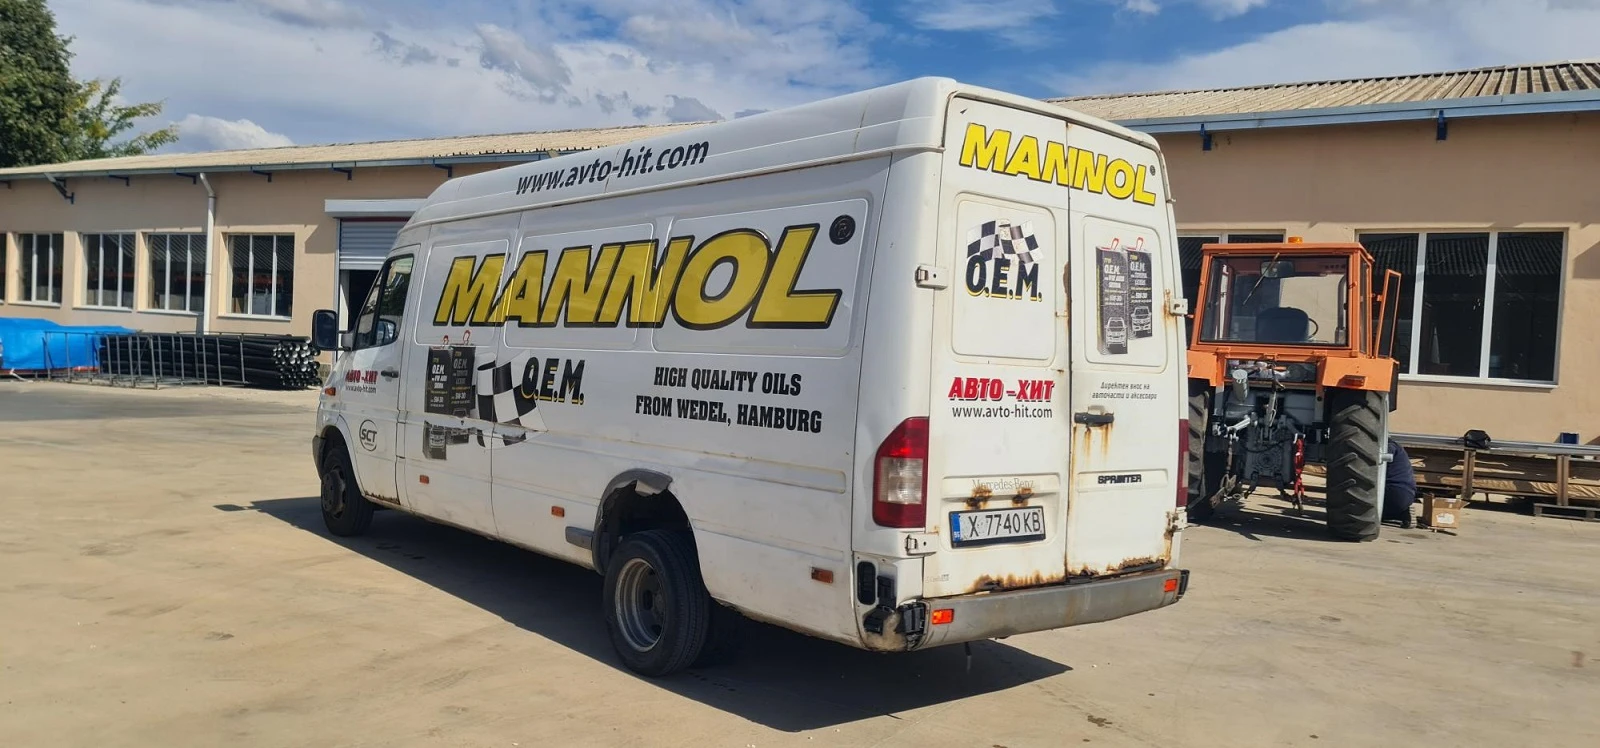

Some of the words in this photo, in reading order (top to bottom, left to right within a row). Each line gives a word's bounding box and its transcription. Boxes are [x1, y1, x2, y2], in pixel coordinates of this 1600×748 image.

[516, 138, 710, 196] www.avto-hit.com
[959, 122, 1156, 206] MANNOL
[433, 223, 843, 331] MANNOL
[965, 255, 1043, 303] O.E.M.
[520, 356, 586, 406] O.E.M.
[653, 366, 687, 389] HIGH
[691, 369, 758, 393] QUALITY
[762, 373, 802, 396] OILS
[948, 376, 1003, 401] АВТО
[635, 395, 672, 417] FROM
[676, 398, 732, 426] WEDEL,
[736, 404, 822, 434] HAMBURG
[951, 404, 1053, 419] www.avto-hit.com
[360, 428, 378, 443] SCT
[972, 477, 1035, 491] Mercedes-Benz
[1098, 474, 1142, 484] SPRINTER
[985, 513, 1021, 536] 7740
